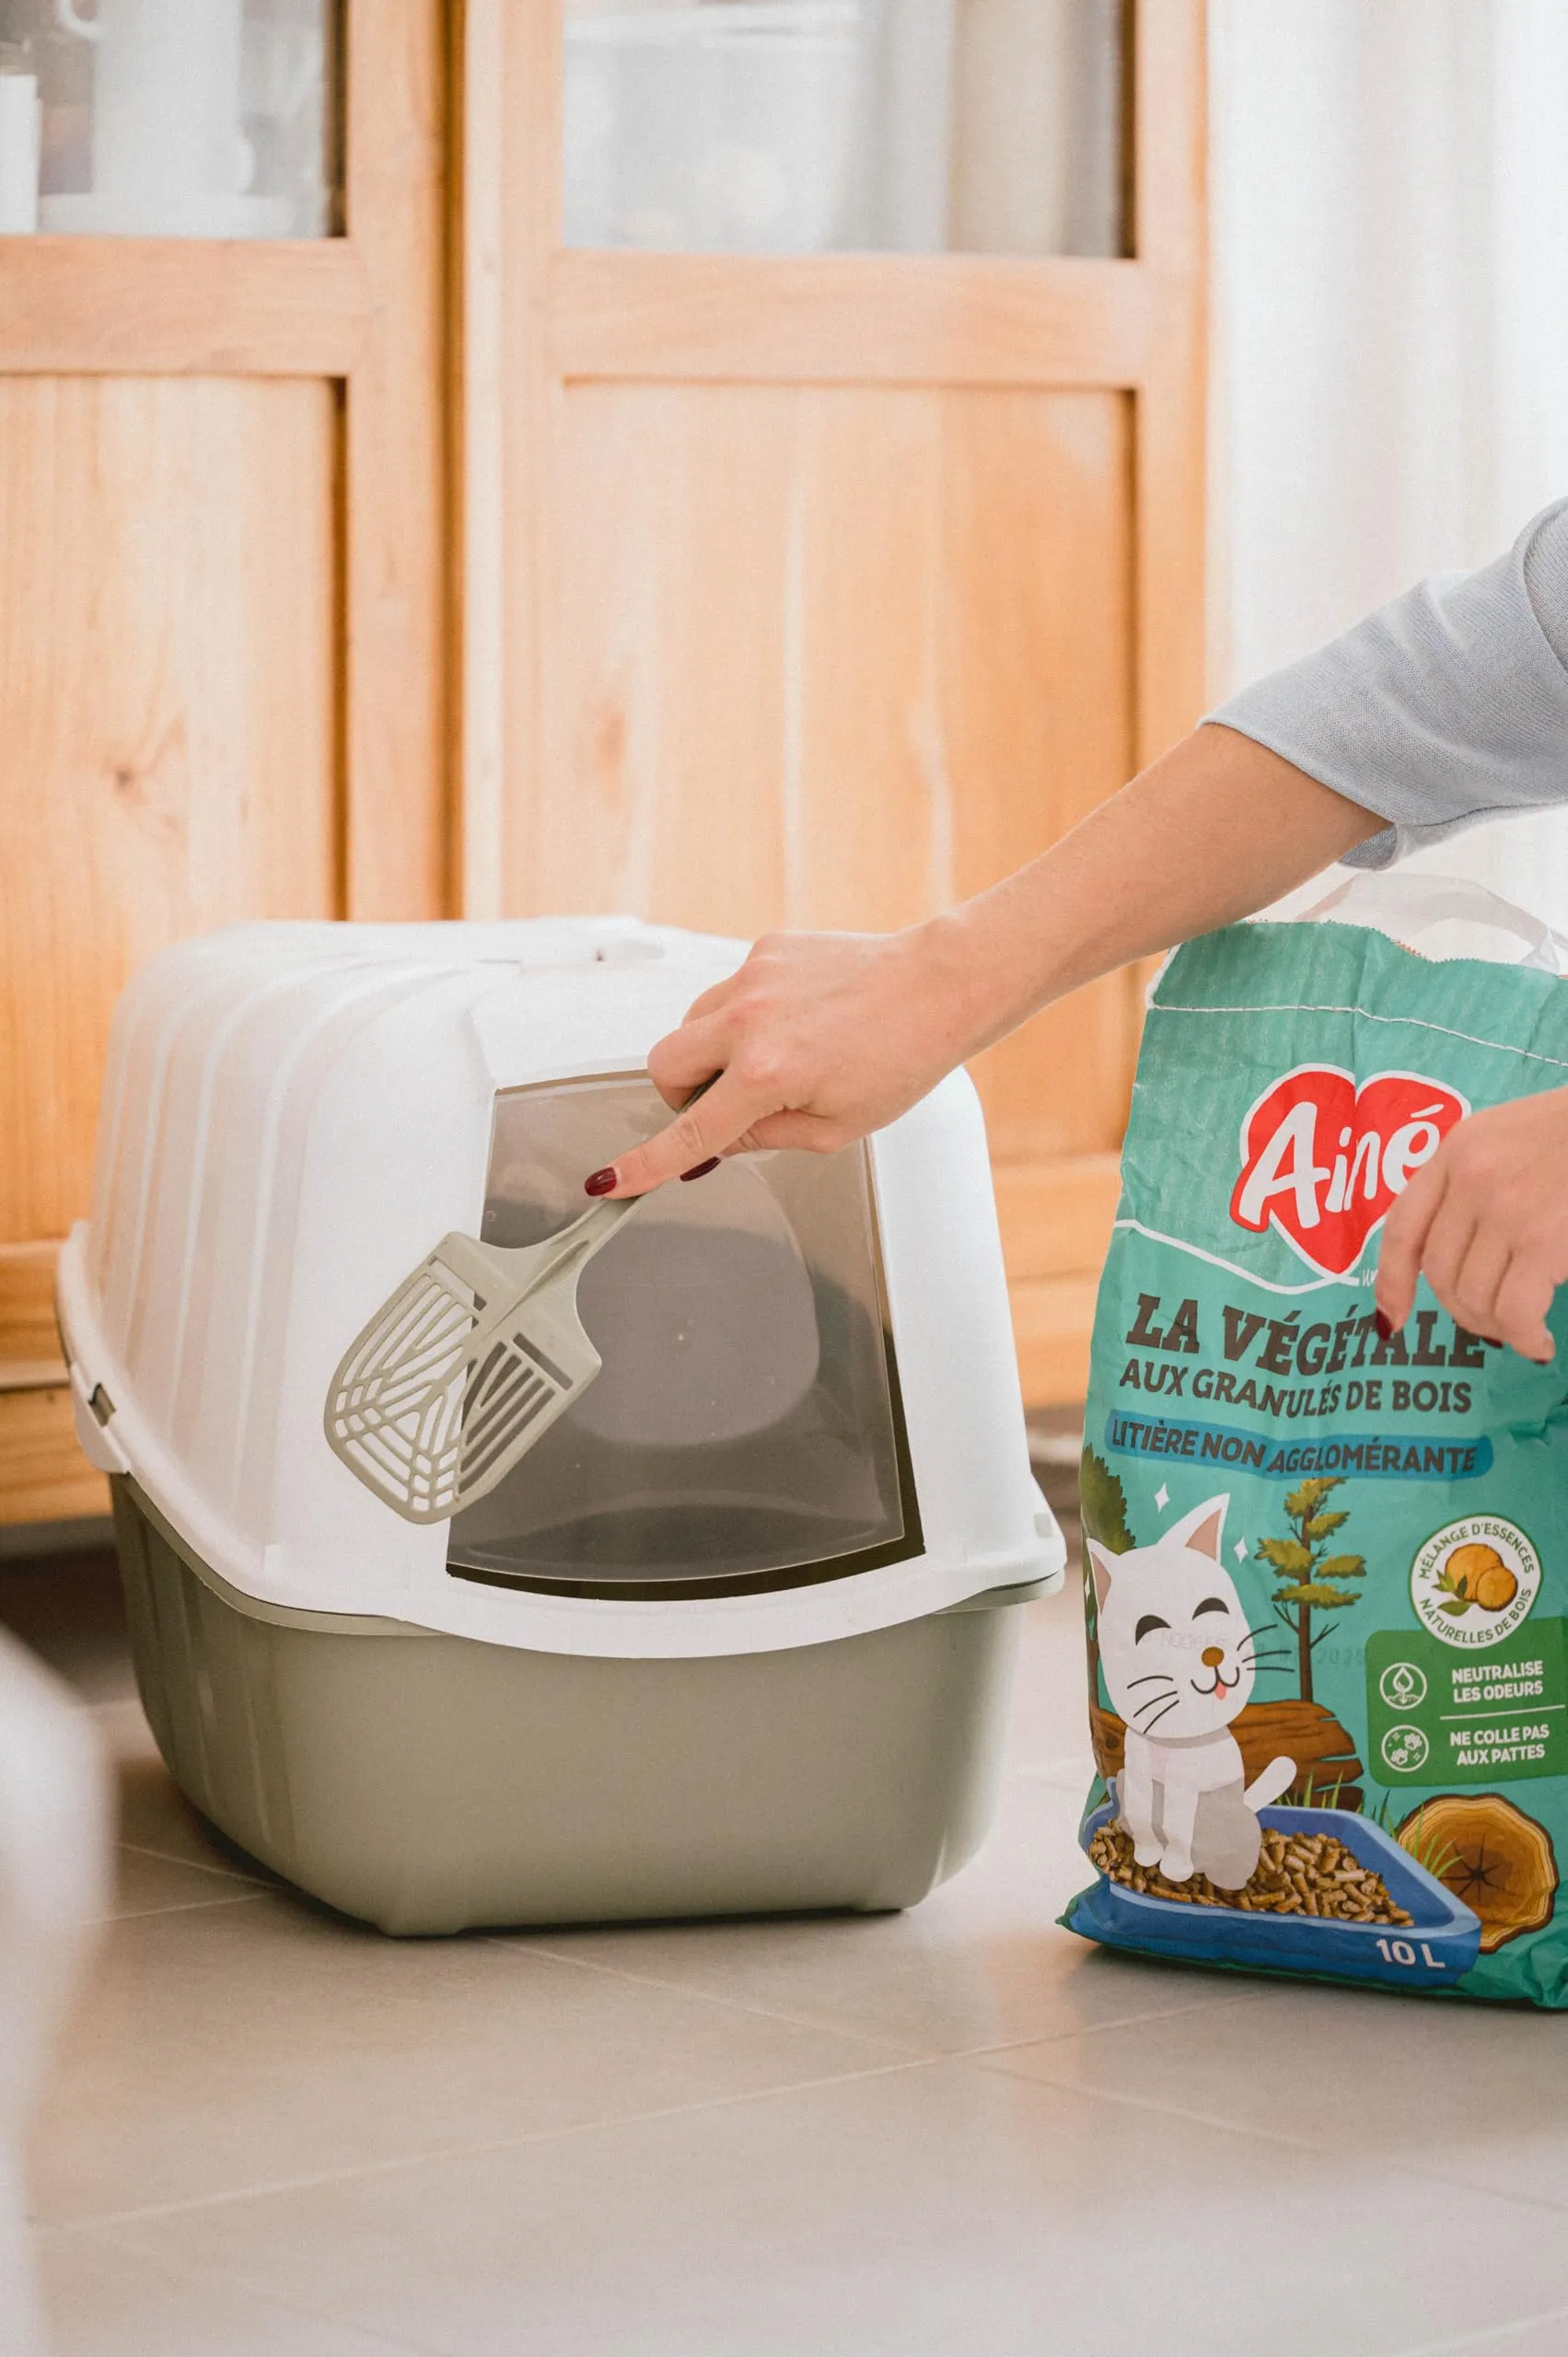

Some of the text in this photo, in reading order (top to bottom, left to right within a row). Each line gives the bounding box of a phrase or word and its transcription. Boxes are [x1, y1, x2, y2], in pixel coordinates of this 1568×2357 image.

[1125, 1293, 1486, 1376] LA VÉGÉTALE
[1119, 1358, 1472, 1419] AUX GRANULÉS DE BOIS
[1112, 1419, 1478, 1474] LITIÈRE NON AGGLOMÉRANTE
[1471, 1522, 1535, 1574] D'ESSENCES
[1419, 1588, 1533, 1644] NATURELLES DE BOIS
[1451, 1660, 1544, 1685] NEUTRALISE
[1453, 1679, 1544, 1703] LES ODEURS
[1450, 1724, 1551, 1747] NE COLLE PAS
[1457, 1744, 1546, 1766] AUX PATTES
[1375, 1938, 1446, 1968] 10 L
